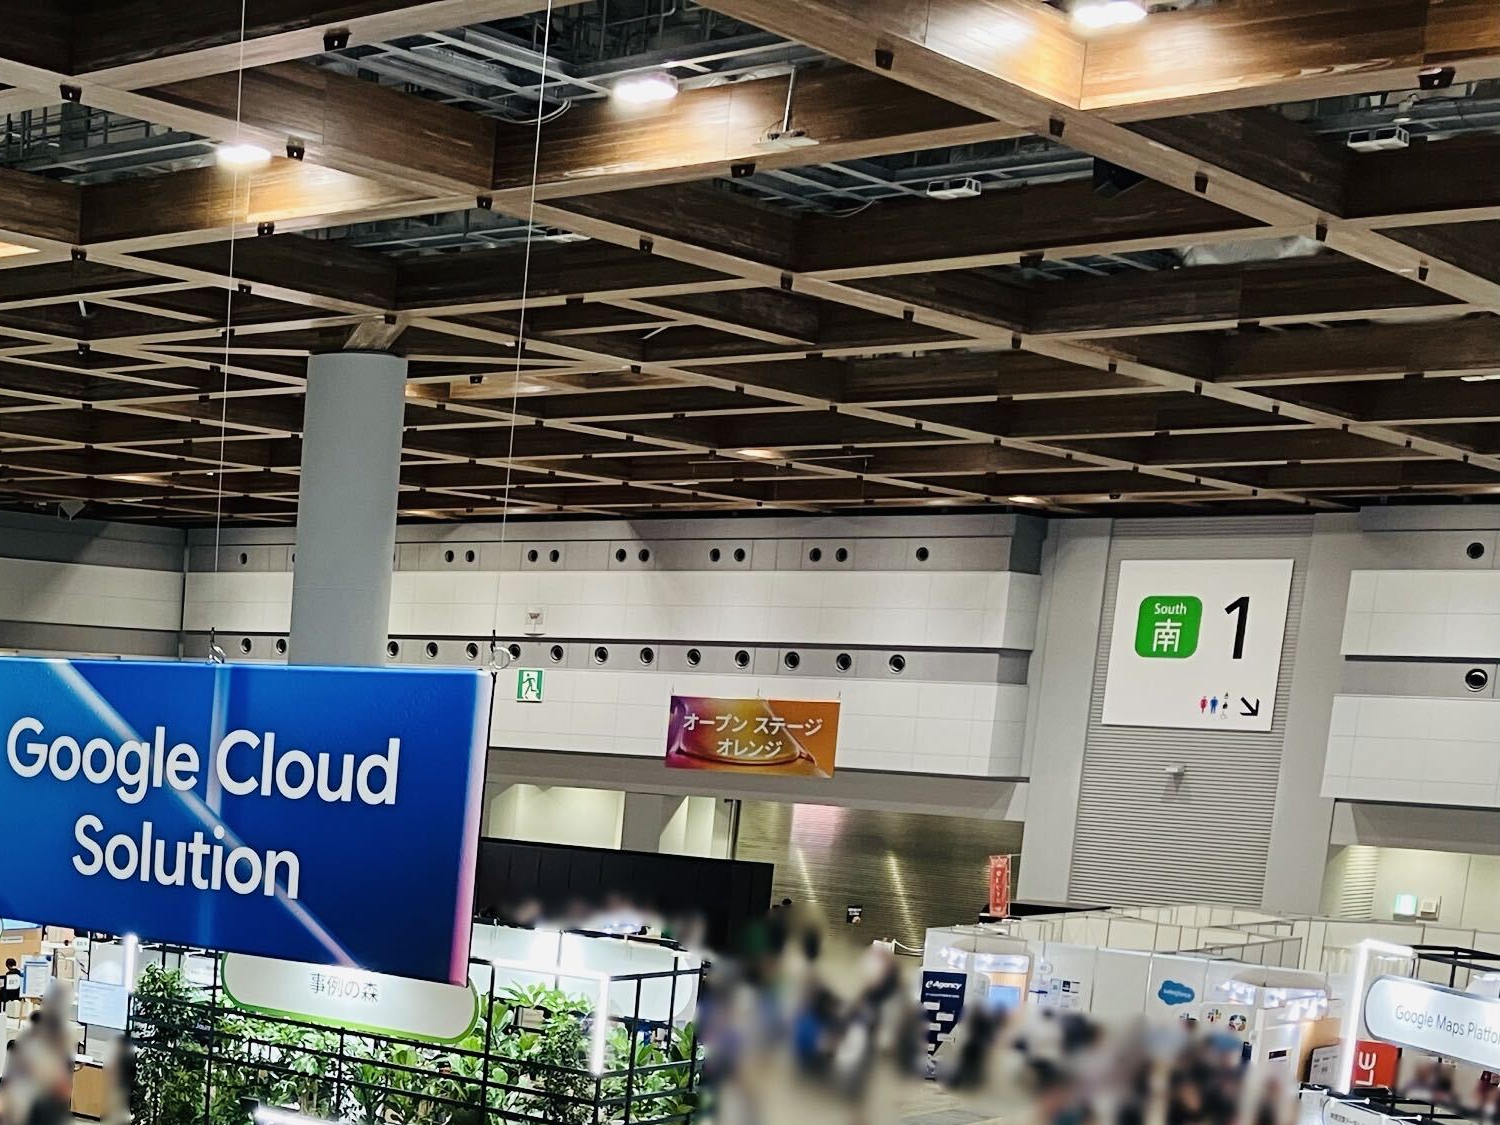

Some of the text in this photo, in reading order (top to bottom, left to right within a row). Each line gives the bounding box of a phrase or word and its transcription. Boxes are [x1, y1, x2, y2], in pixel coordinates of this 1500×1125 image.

[1154, 602, 1187, 615] South
[1152, 618, 1182, 652] 南
[1224, 596, 1250, 660] 1
[683, 713, 823, 736] オープン ステージ
[7, 717, 401, 806] Google Cloud
[716, 738, 783, 759] オレンジ
[71, 814, 300, 899] Solution
[309, 972, 379, 1003] 事例の森
[1395, 1004, 1434, 1030] Google
[1436, 1013, 1465, 1038] Maps
